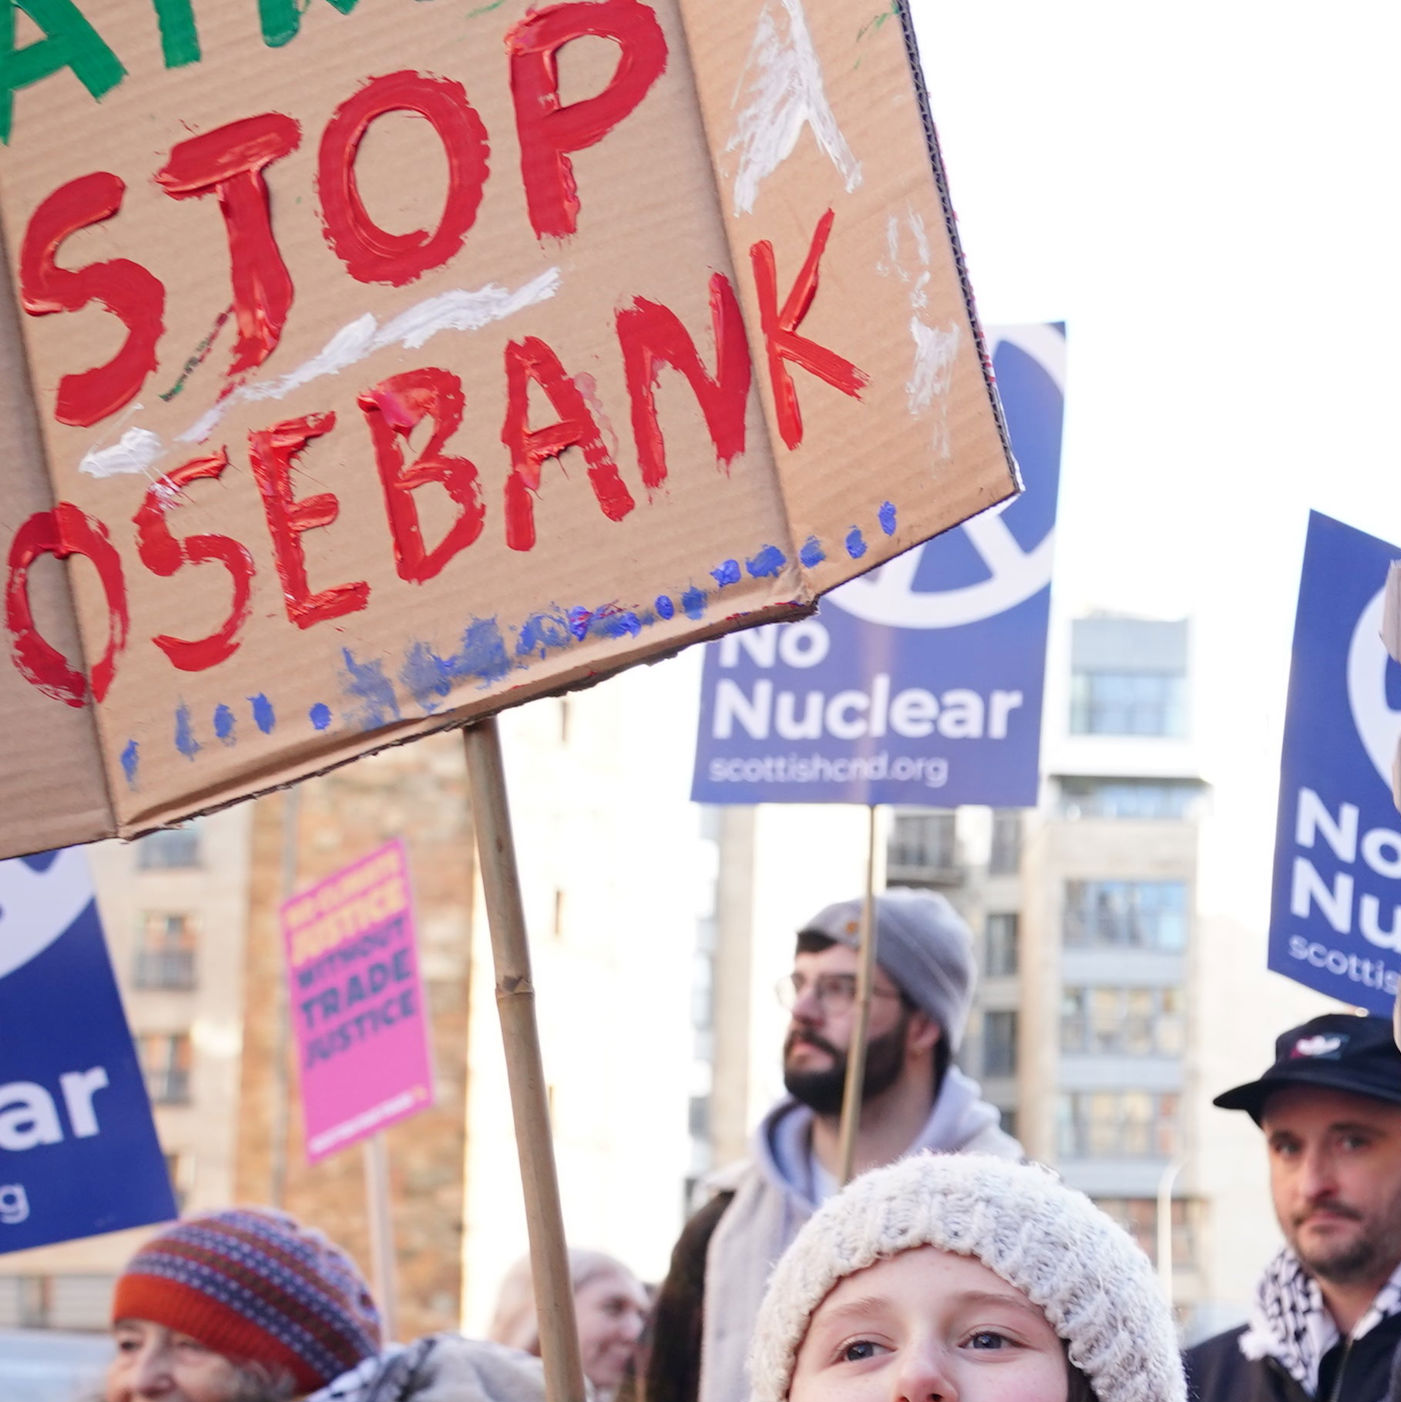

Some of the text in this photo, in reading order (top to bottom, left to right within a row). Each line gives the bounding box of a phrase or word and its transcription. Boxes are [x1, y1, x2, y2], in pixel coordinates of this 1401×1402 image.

[18, 1, 669, 428] STOP
[718, 619, 830, 668] No
[711, 672, 1024, 741] Nuclear
[708, 751, 950, 789] scottishcnd.org
[301, 947, 413, 1030] TRADE
[304, 987, 416, 1070] JUSTICE
